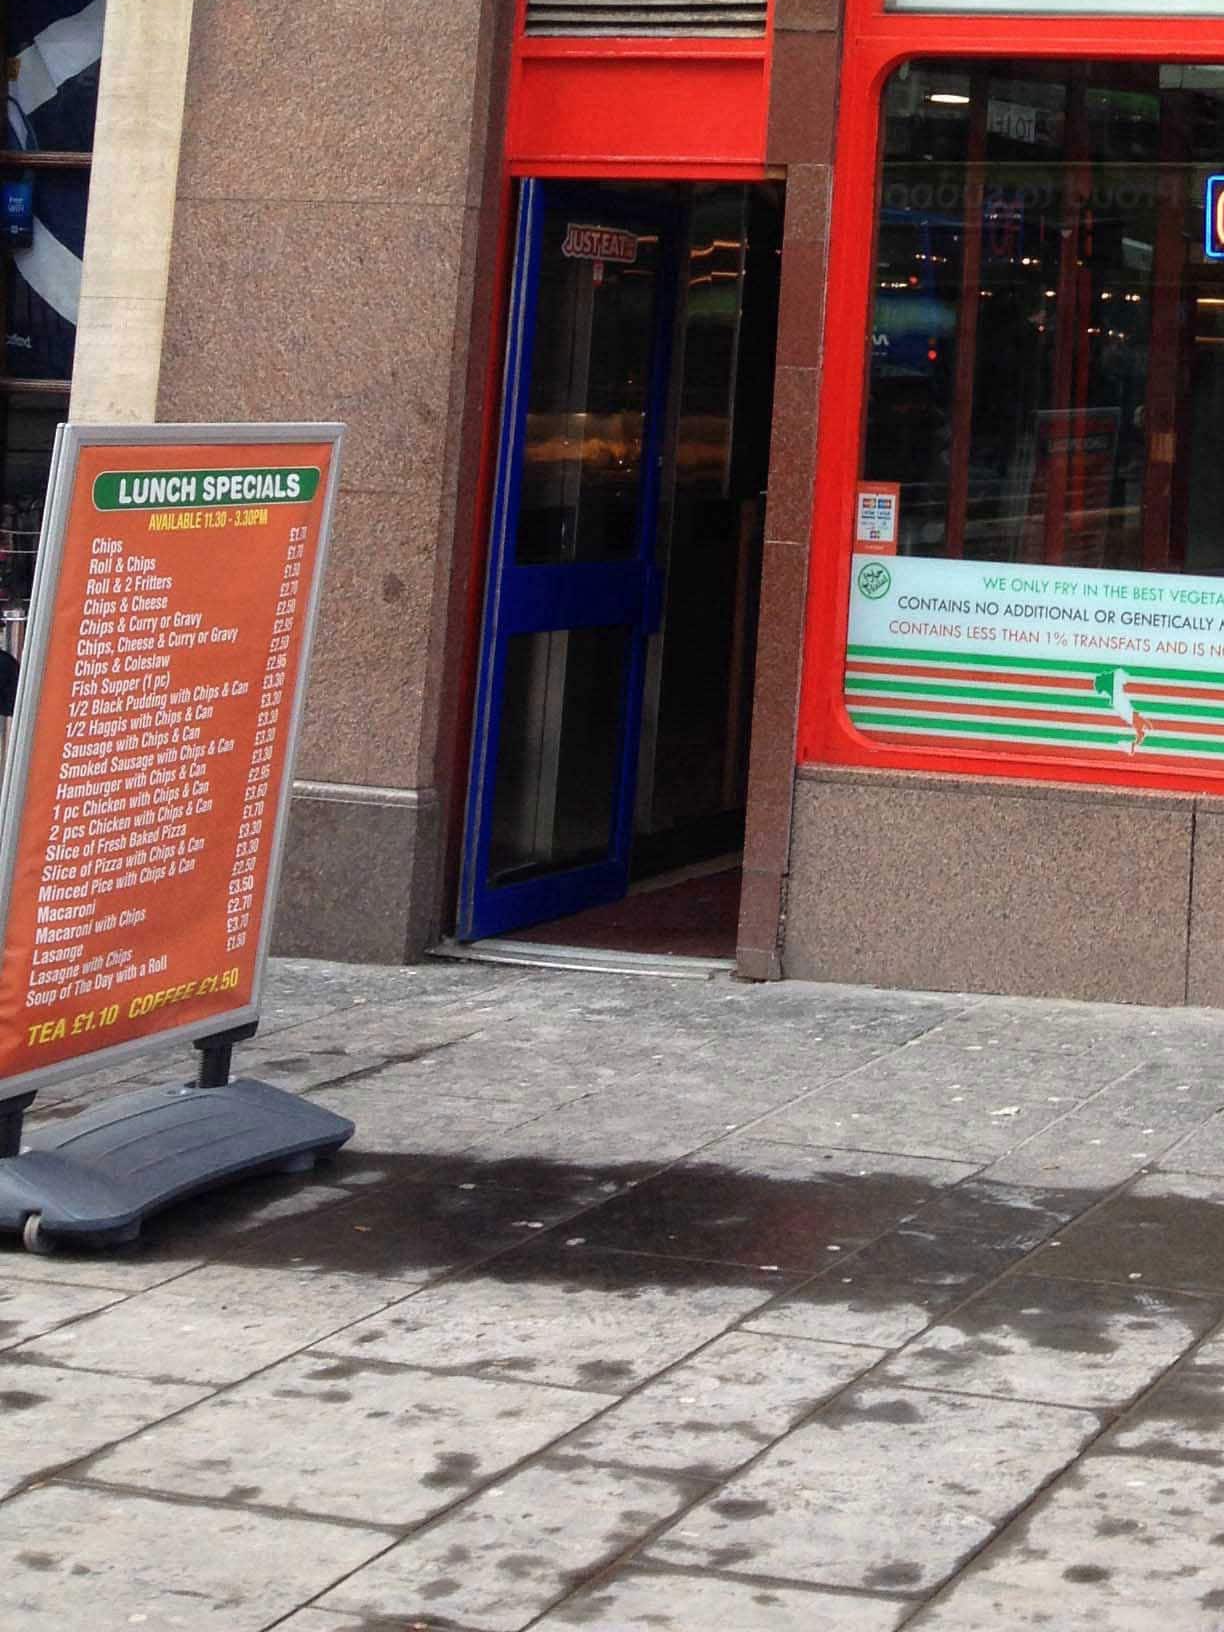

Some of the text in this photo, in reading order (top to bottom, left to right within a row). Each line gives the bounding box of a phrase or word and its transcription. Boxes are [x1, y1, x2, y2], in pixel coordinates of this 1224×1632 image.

[566, 229, 626, 257] JUST EAT
[118, 473, 300, 503] LUNCH SPECIALS
[148, 508, 268, 530] AVAILABLE 11.30 3.30PM
[92, 537, 122, 555] Chips
[89, 555, 156, 574] Roll Chips
[86, 575, 172, 595] Roll 2 Fritters
[984, 577, 1006, 592] WE
[1011, 578, 1049, 594] ONLY
[1054, 580, 1079, 595] FRY
[1083, 581, 1099, 597] IN
[1103, 583, 1129, 600] THE
[1133, 586, 1164, 602] BEST
[83, 595, 168, 616] Chips Cheese
[898, 596, 970, 614] CONTAINS
[975, 601, 1000, 616] NO
[1004, 603, 1089, 623] ADDITIONAL
[1094, 610, 1116, 625] OR
[1120, 611, 1213, 631] GENETICALLY
[79, 611, 202, 636] Chips Curry or Gravy
[117, 626, 238, 652] Cheese Curry or Gravy
[889, 620, 962, 639] CONTAINS
[967, 626, 997, 641] LESS
[1001, 628, 1040, 644] THAN
[1046, 632, 1069, 647] 1%
[1073, 634, 1151, 652] TRANSFATS
[1156, 641, 1188, 655] AND
[1193, 643, 1205, 657] IS
[74, 653, 170, 677] Chips Coleslaw
[68, 684, 219, 717] 1/2 Black Pudding with Chips
[71, 678, 140, 697] Fish Supper
[65, 704, 213, 737] 1/2 Haggis with Chips Can
[62, 725, 200, 758] Sausage with Chips Can
[59, 758, 108, 779] Smoked
[110, 753, 154, 772] Sausage
[55, 779, 122, 799] Hamburger
[124, 771, 146, 789] with
[149, 767, 176, 785] Chips
[63, 805, 79, 823] pc
[82, 797, 126, 816] Chicken
[129, 790, 150, 808] with
[152, 786, 179, 804] Chips
[48, 824, 59, 840] 2
[62, 824, 85, 843] pcs
[87, 815, 131, 835] Chicken
[133, 809, 155, 826] with
[157, 804, 183, 822] Chips
[45, 843, 79, 861] Slice
[82, 839, 95, 856] of
[96, 833, 126, 854] Fresh
[128, 826, 159, 847] Baked
[160, 823, 186, 840] Pizza
[41, 864, 76, 881] Slice
[79, 860, 92, 877] of
[93, 857, 123, 874] Pizza
[38, 880, 88, 902] Minced
[37, 902, 95, 923] Macaroni
[35, 919, 92, 944] Macaroni
[25, 989, 56, 1007] Soup
[59, 982, 72, 999] of
[93, 973, 113, 990] Day
[147, 954, 167, 973] Roll
[27, 967, 239, 1047] TEA £1.10 COFFEE £1.50
